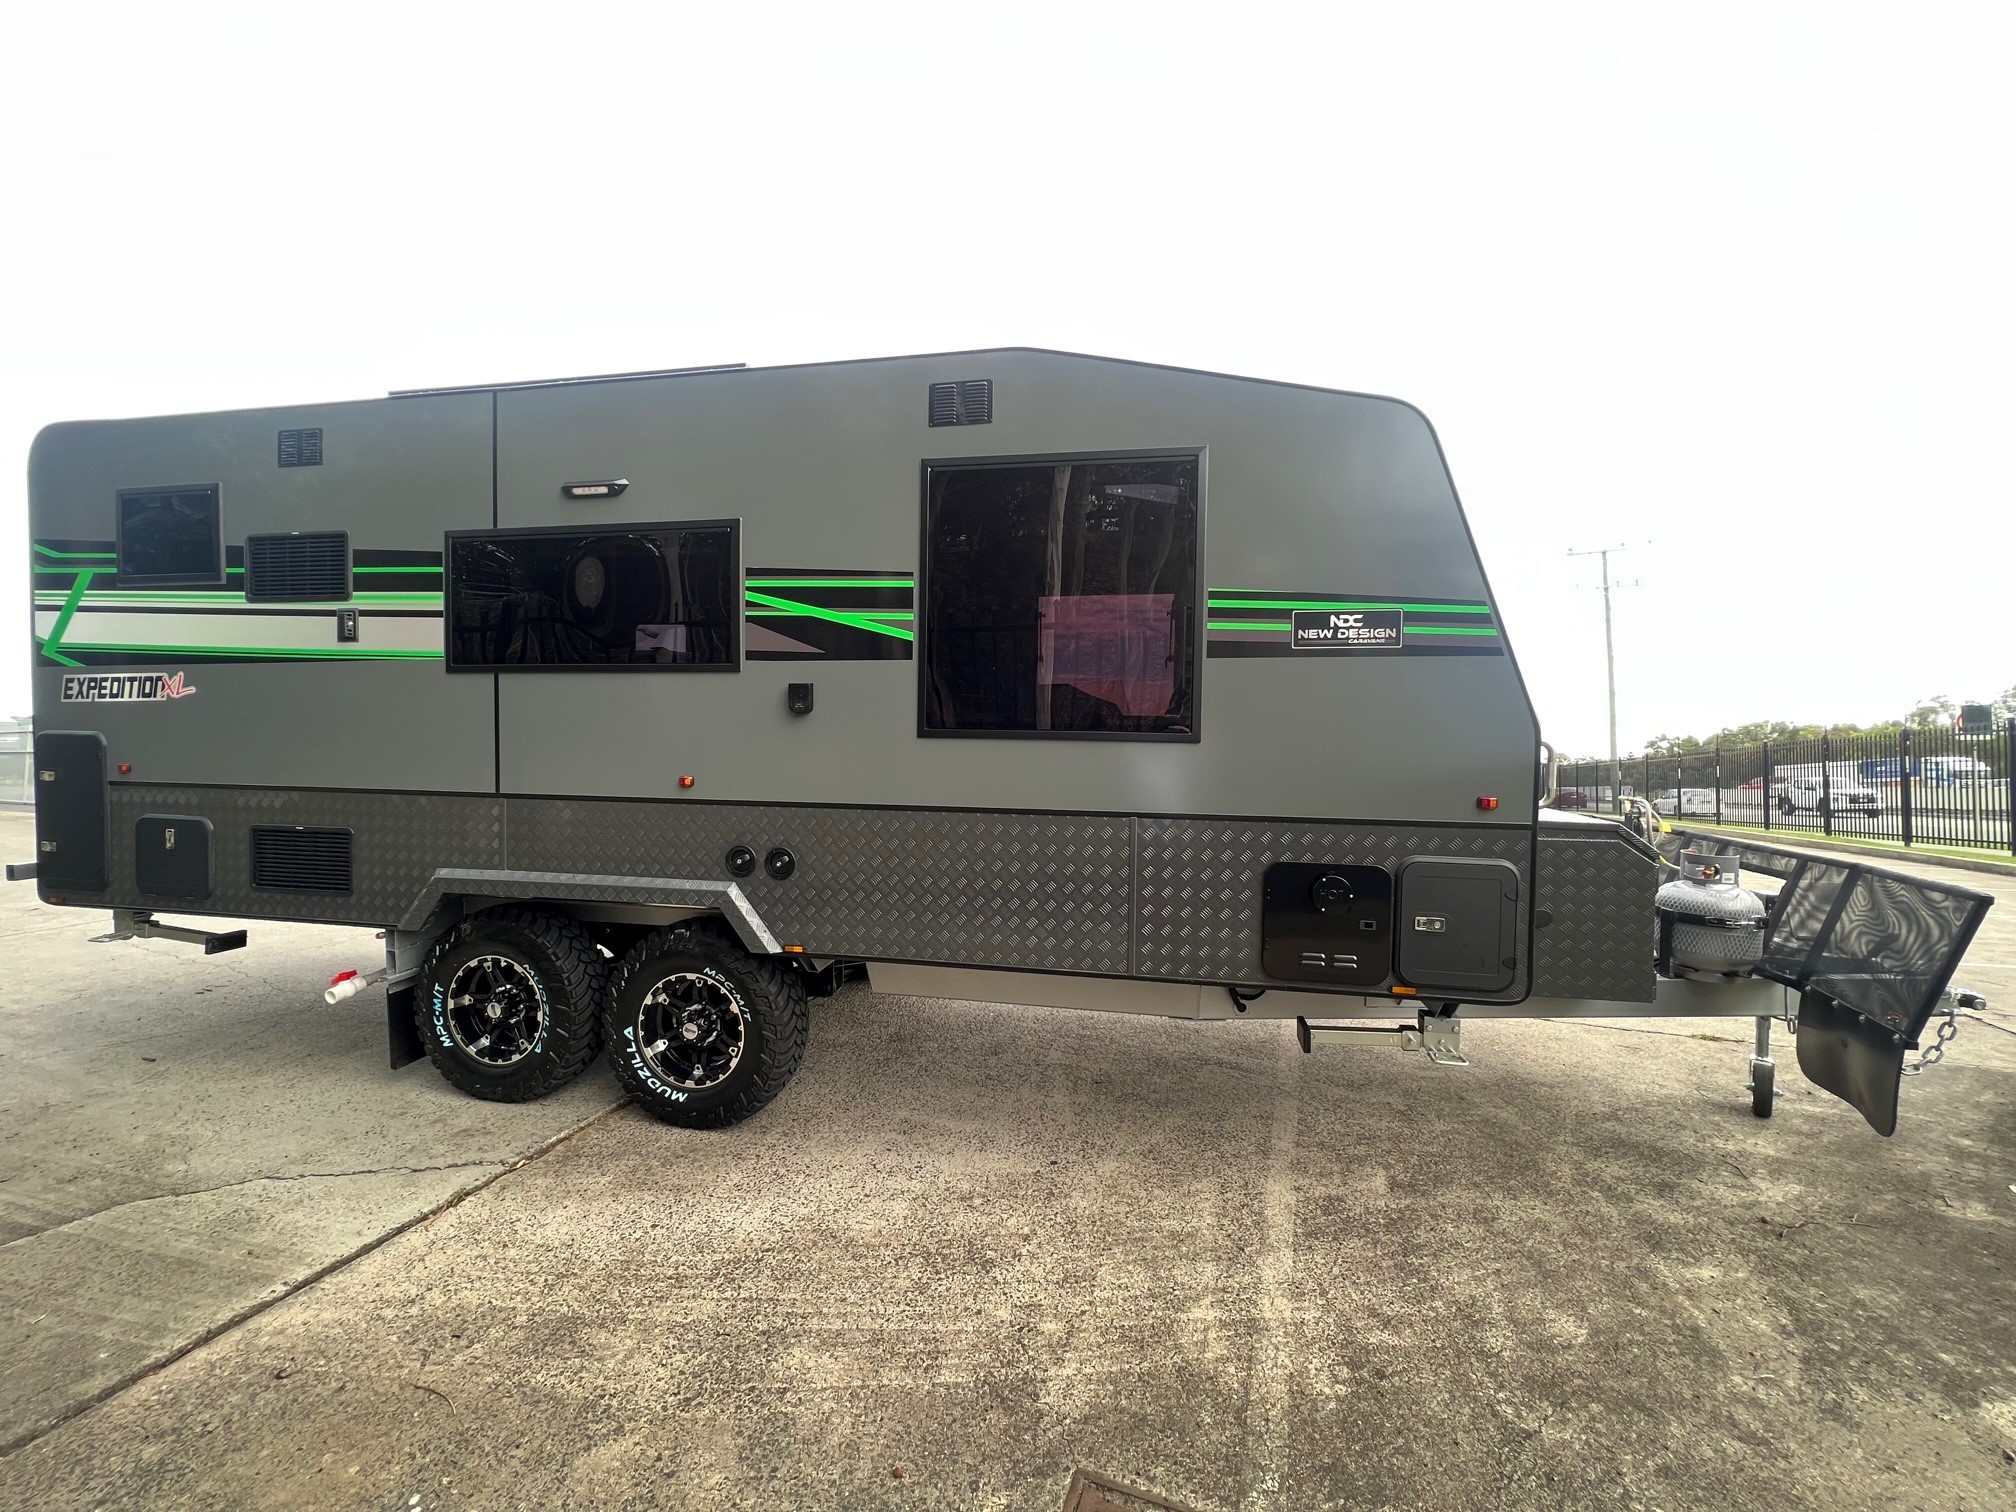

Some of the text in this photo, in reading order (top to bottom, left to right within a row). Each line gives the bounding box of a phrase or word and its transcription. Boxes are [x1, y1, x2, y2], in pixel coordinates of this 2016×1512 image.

[1297, 628, 1397, 639] NEW DESIGN
[1329, 614, 1364, 628] NDC
[432, 982, 454, 1048] MPC-M/T
[703, 966, 752, 1022] MPC-M/T
[623, 1025, 689, 1103] MUDZILLA
